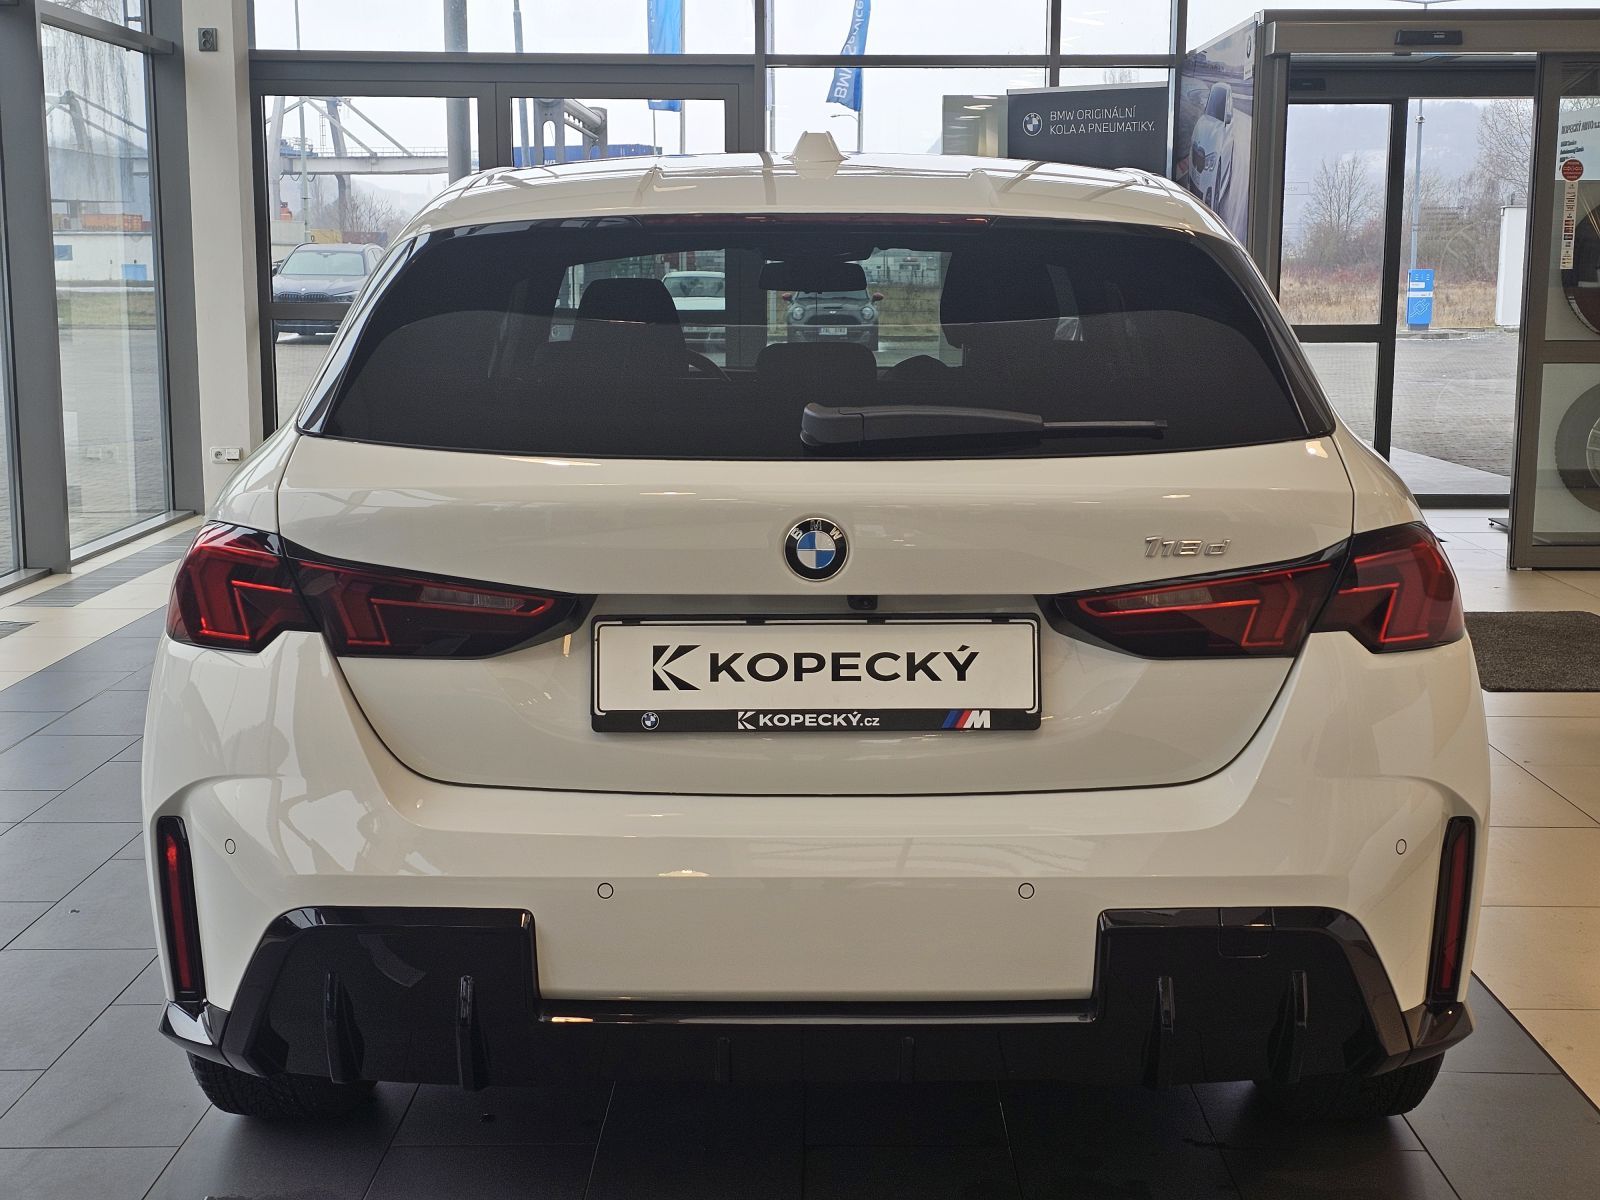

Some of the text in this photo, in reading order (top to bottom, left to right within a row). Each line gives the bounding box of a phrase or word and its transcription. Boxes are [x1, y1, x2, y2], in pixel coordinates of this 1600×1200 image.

[1050, 110, 1075, 121] BMW
[1076, 105, 1137, 120] ORIGINÁLNÍ
[1050, 121, 1155, 135] KOLA A PNEUMATIKY.
[709, 644, 980, 683] KOPECKÝ
[759, 711, 880, 727] KOPECKÝ.cz
[962, 709, 991, 729] M
